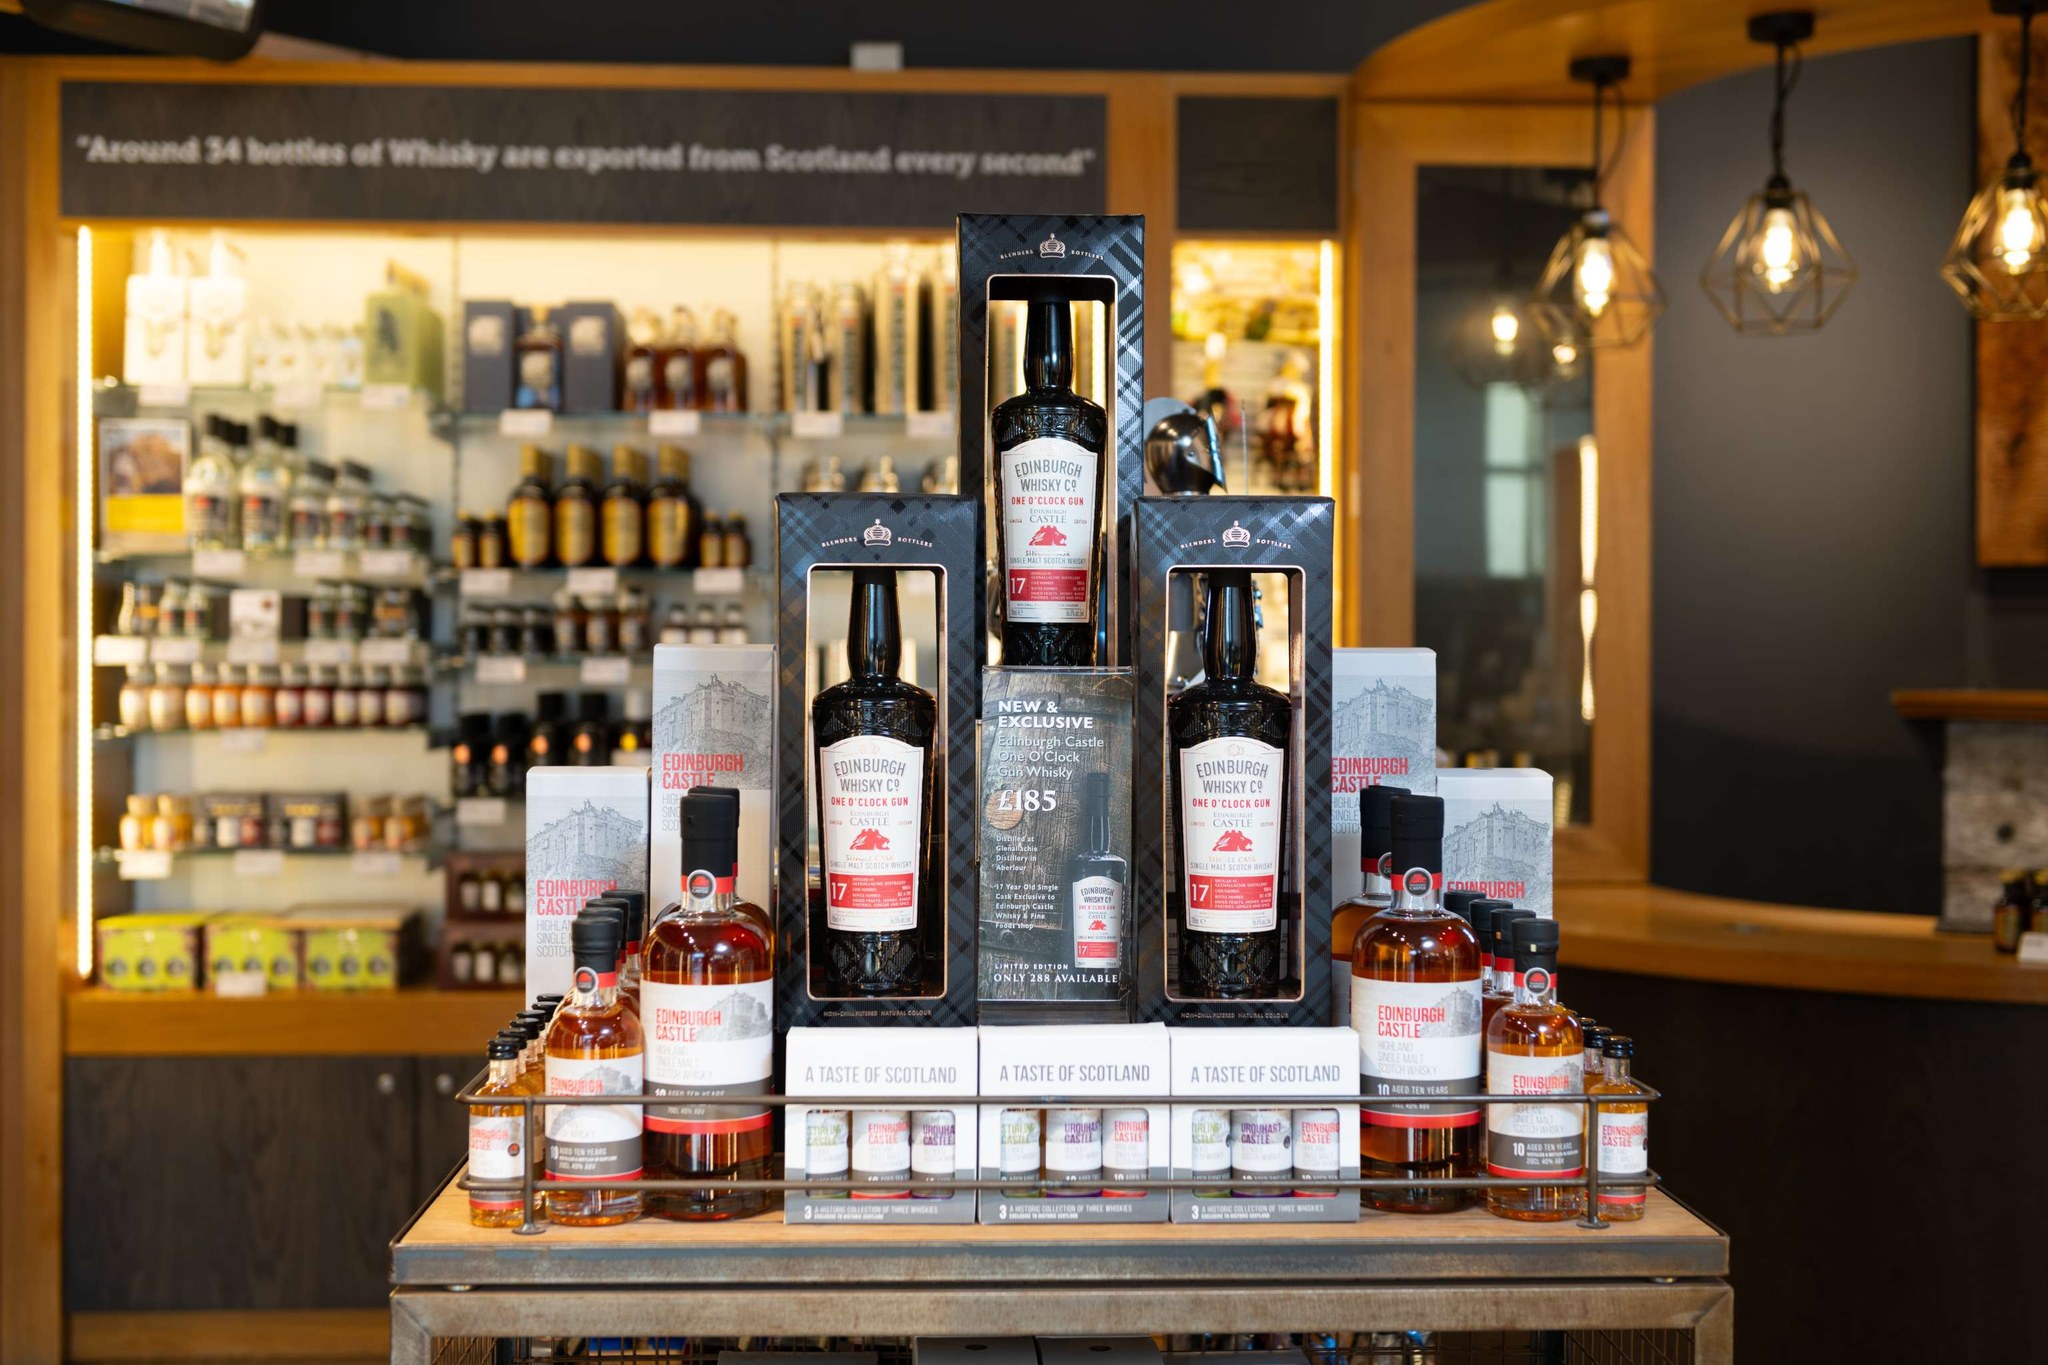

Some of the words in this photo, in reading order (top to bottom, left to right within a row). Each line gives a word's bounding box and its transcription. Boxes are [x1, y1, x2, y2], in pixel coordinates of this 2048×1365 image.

[246, 136, 349, 167] bottles
[351, 137, 384, 167] of
[387, 137, 498, 174] Whisky
[502, 144, 550, 170] are
[553, 143, 684, 175] exported
[688, 142, 761, 171] from
[764, 142, 892, 174] Scotland
[895, 151, 977, 179] every
[1000, 249, 1034, 260] BLENDERS
[1071, 250, 1104, 260] BOTTLERS
[1014, 459, 1083, 478] EDINBURGH
[1020, 479, 1062, 491] WHISKY
[1011, 496, 1026, 505] ONE
[1028, 496, 1066, 505] O'CLOCK
[1068, 496, 1084, 506] GUN
[1029, 514, 1067, 524] CASTLE
[821, 537, 858, 548] BLENDERS
[898, 537, 933, 548] BOTTLERS
[1180, 538, 1216, 549] BLENDERS
[1256, 538, 1292, 549] BOTTLERS
[1067, 557, 1086, 565] WHISKY
[1010, 577, 1026, 594] 17
[998, 700, 1042, 713] NEW
[1046, 700, 1059, 713] &
[998, 715, 1094, 729] EXCLUSIVE
[998, 735, 1061, 750] Edinburgh
[1065, 736, 1105, 748] Castle
[662, 753, 744, 771] EDINBURGH
[998, 751, 1025, 763] One
[1029, 751, 1080, 763] O'Clock
[833, 758, 906, 777] EDINBURGH
[1195, 759, 1269, 778] EDINBURGH
[1331, 757, 1409, 775] EDINBURGH
[998, 766, 1023, 778] Gun
[1026, 766, 1073, 780] Whisky
[662, 772, 716, 789] CASTLE
[840, 778, 883, 792] WHISKY
[1202, 780, 1247, 793] WHISKY
[831, 797, 845, 806] ONE
[848, 797, 888, 807] O'CLOCK
[891, 797, 909, 806] GUN
[997, 789, 1057, 812] £185
[1192, 798, 1208, 807] ONE
[1211, 798, 1251, 808] O'CLOCK
[1254, 798, 1271, 807] GUN
[849, 817, 890, 826] CASTLE
[1213, 819, 1253, 828] CASTLE
[891, 861, 912, 869] WHISKY
[996, 855, 1029, 863] Distillery
[1210, 863, 1226, 871] MALT
[1228, 863, 1252, 871] SCOTCH
[1253, 862, 1273, 870] WHISKY
[536, 879, 617, 897] EDINBURGH
[831, 882, 848, 900] 17
[1037, 884, 1059, 892] Single
[1080, 885, 1114, 896] EDINBURGH
[1191, 883, 1210, 902] 17
[1447, 880, 1525, 898] EDINBURGH
[996, 903, 1030, 911] Edinburgh
[1078, 945, 1087, 954] 17
[993, 973, 1026, 982] ONLY
[1030, 973, 1050, 982] 288
[1054, 974, 1118, 983] AVAILABLE
[655, 1008, 722, 1026] EDINBURGH
[1378, 1005, 1445, 1022] EDINBURGH
[655, 1025, 697, 1042] CASTLE
[1378, 1021, 1422, 1038] CASTLE
[805, 1066, 814, 1083] A
[818, 1066, 860, 1083] TASTE
[864, 1066, 881, 1083] OF
[885, 1066, 957, 1083] SCOTLAND
[1000, 1065, 1009, 1082] A
[1013, 1065, 1054, 1082] TASTE
[1058, 1065, 1076, 1082] OF
[1079, 1065, 1150, 1082] SCOTLAND
[1191, 1066, 1200, 1083] A
[1204, 1066, 1245, 1083] TASTE
[1249, 1066, 1267, 1082] OF
[1270, 1065, 1340, 1082] SCOTLAND
[1513, 1075, 1569, 1089] EDINBURGH
[1392, 1085, 1409, 1094] AGED
[1411, 1086, 1425, 1095] TEN
[1426, 1086, 1449, 1095] YEARS
[1241, 1122, 1281, 1133] URQUHART
[1065, 1133, 1092, 1144] CASTLE
[1114, 1131, 1142, 1142] CASTLE
[1241, 1133, 1271, 1145] CASTLE
[1302, 1133, 1332, 1144] CASTLE
[1602, 1136, 1632, 1147] CASTLE
[1513, 1142, 1525, 1157] 10
[1526, 1143, 1543, 1152] AGED
[1544, 1143, 1556, 1152] TEN
[804, 1205, 812, 1220] 3
[891, 1206, 909, 1214] THREE
[911, 1206, 938, 1214] WHISKIES
[999, 1205, 1007, 1219] 3
[1009, 1205, 1014, 1213] A
[1041, 1205, 1076, 1213] COLLECTION
[1076, 1205, 1084, 1213] OF
[1086, 1205, 1103, 1213] THREE
[1105, 1205, 1132, 1213] WHISKIES
[1191, 1205, 1199, 1219] 3
[1201, 1205, 1206, 1213] A
[1233, 1205, 1268, 1213] COLLECTION
[1268, 1205, 1275, 1213] OF
[1278, 1205, 1295, 1213] THREE
[1297, 1205, 1324, 1213] WHISKIES
